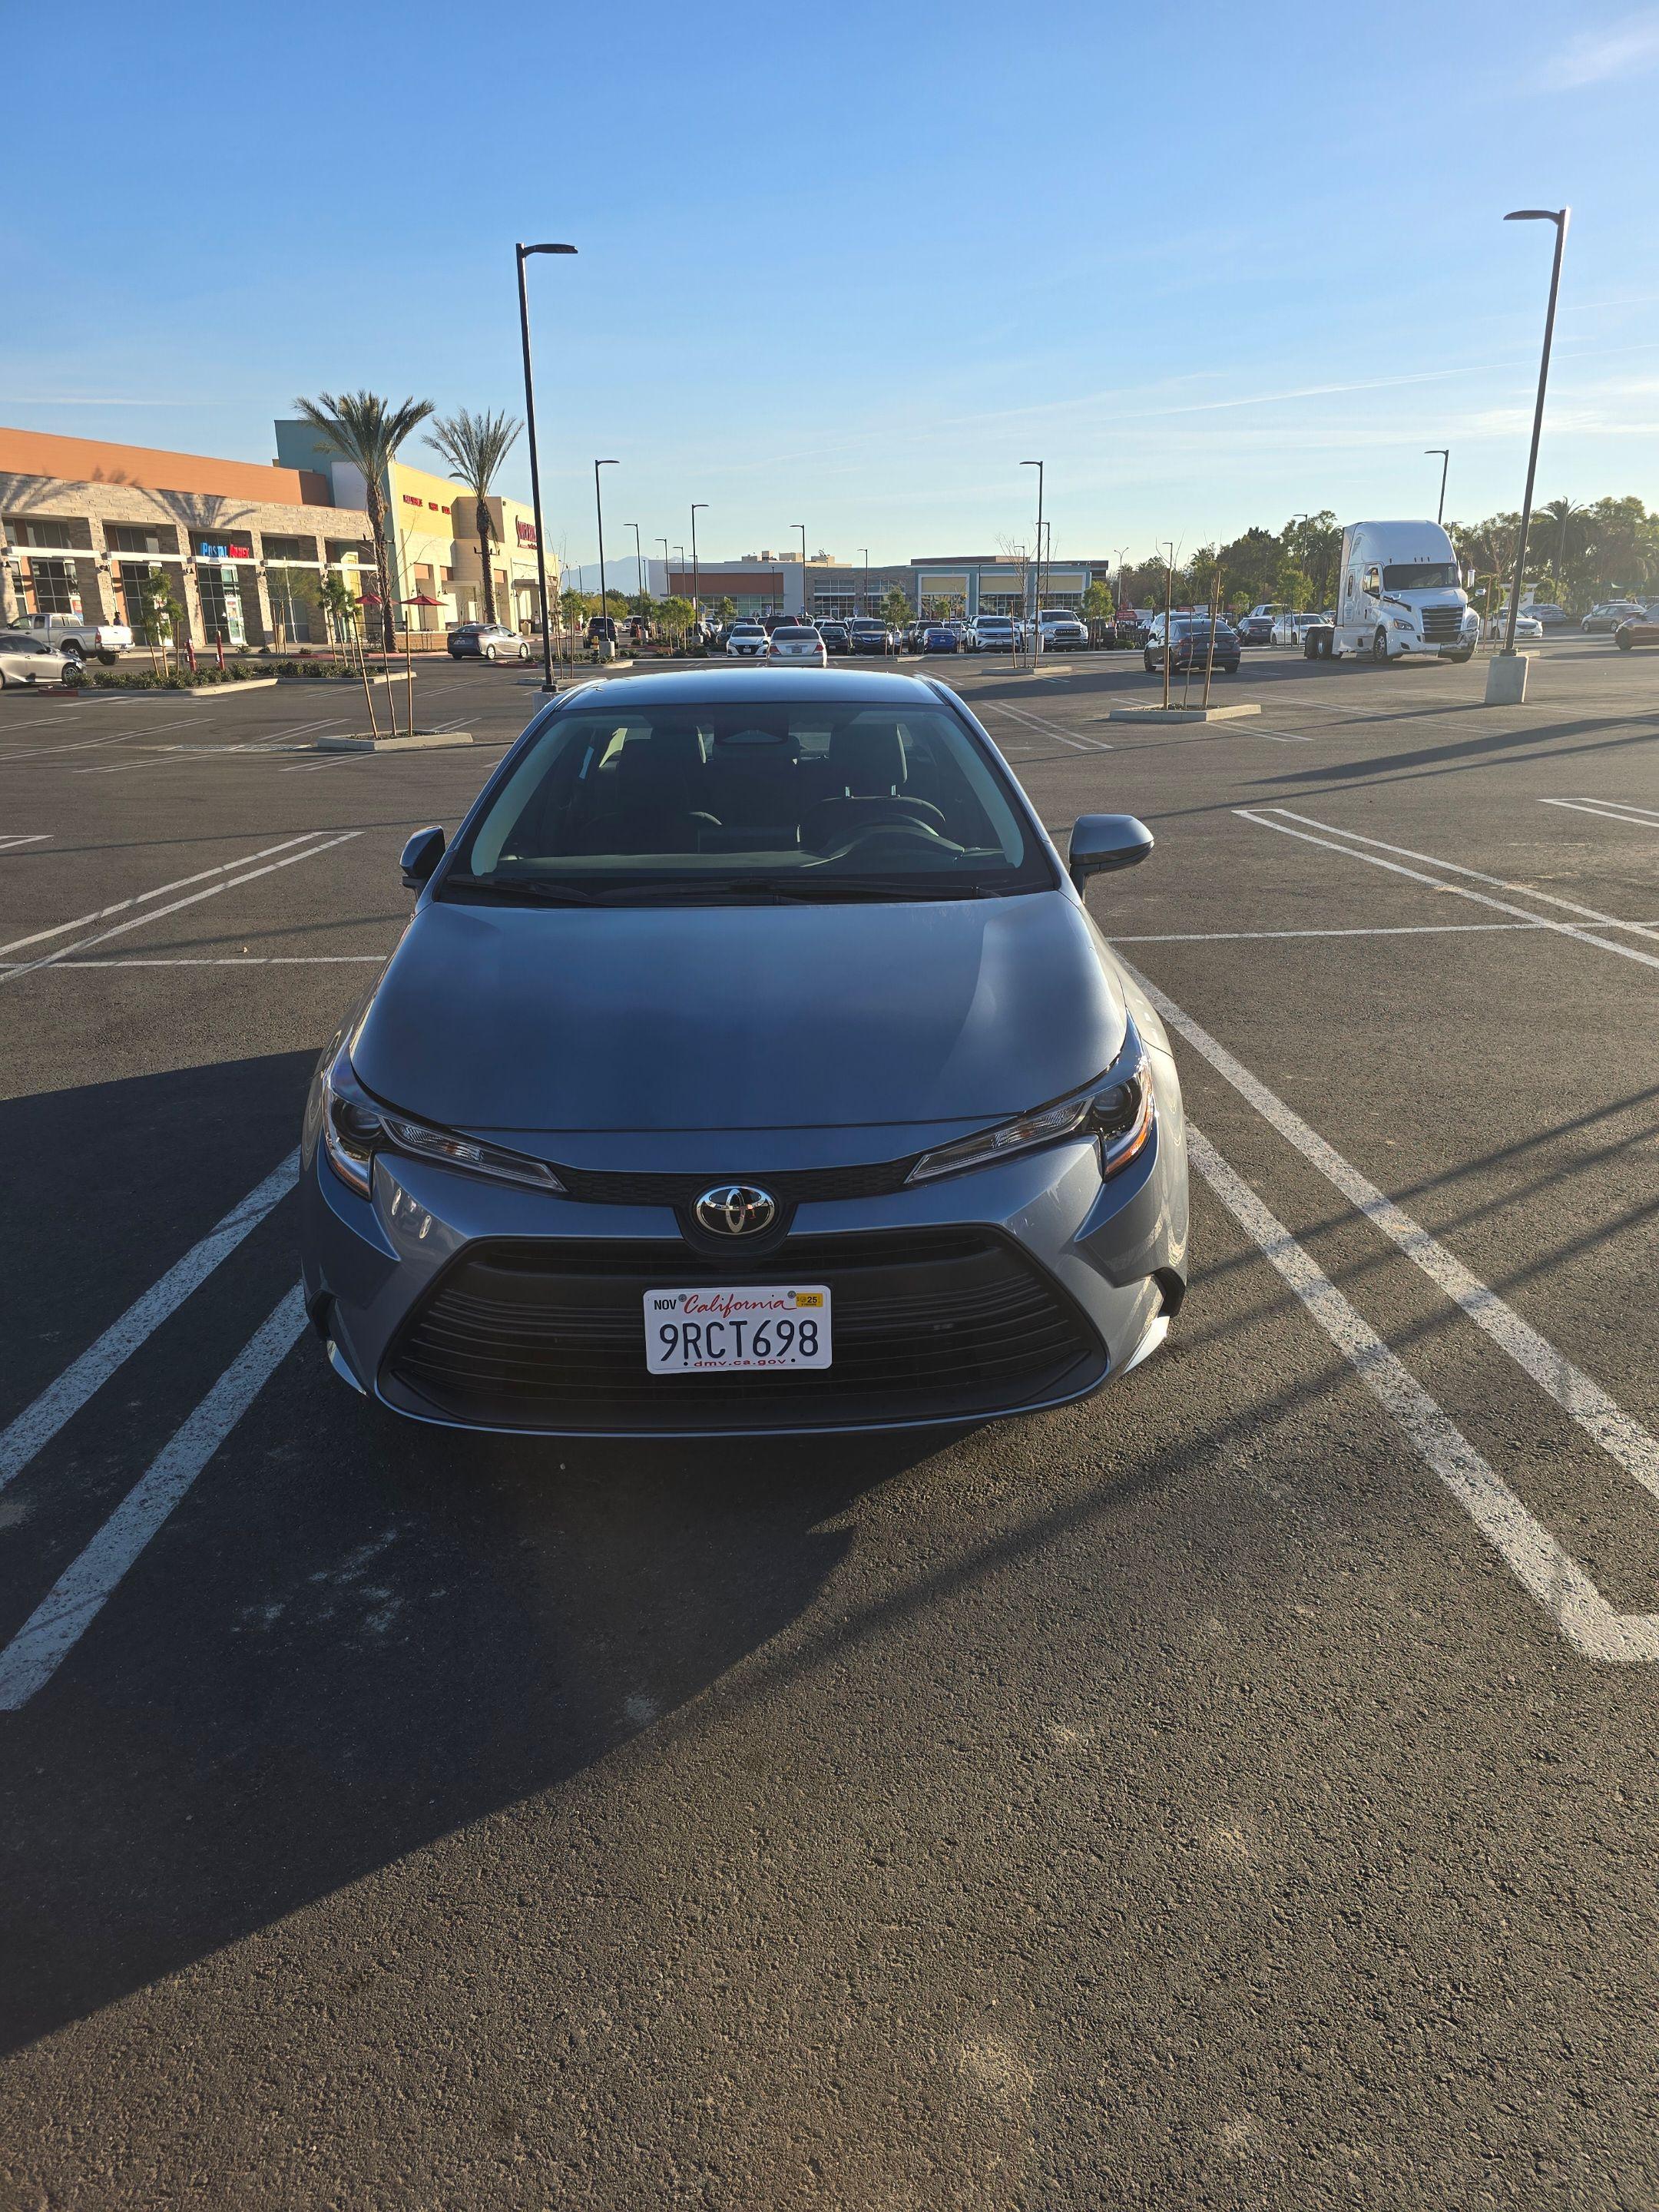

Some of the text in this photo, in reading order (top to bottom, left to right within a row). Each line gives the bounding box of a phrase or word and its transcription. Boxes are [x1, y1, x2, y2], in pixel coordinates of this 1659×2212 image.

[654, 1299, 677, 1310] NOV
[684, 1293, 797, 1319] California
[659, 1320, 819, 1362] 9RCT698
[694, 1358, 786, 1367] dmv.ca.gov
